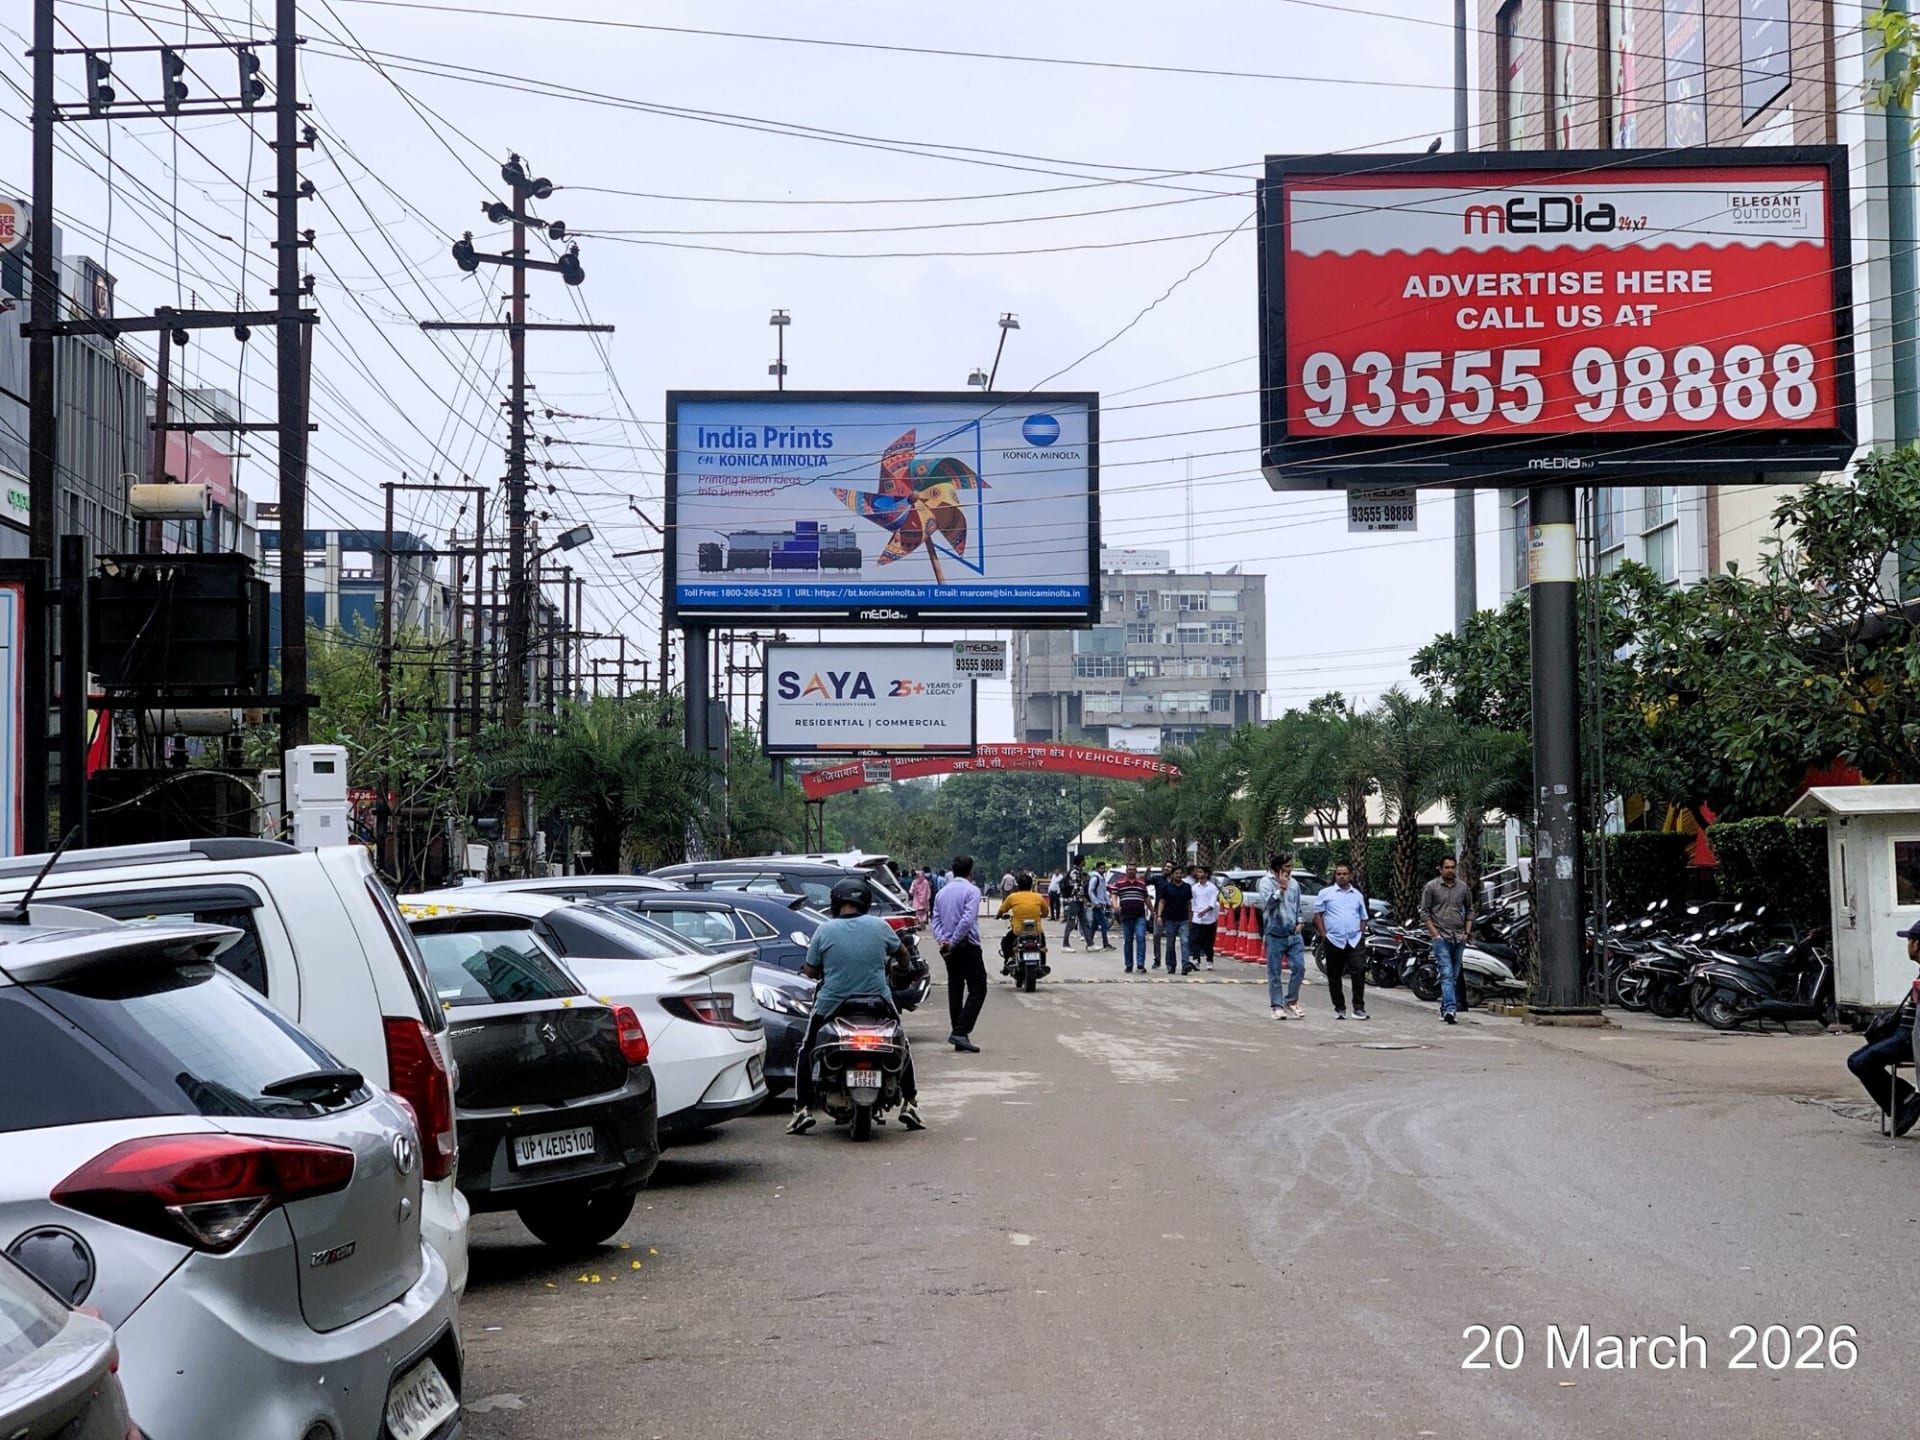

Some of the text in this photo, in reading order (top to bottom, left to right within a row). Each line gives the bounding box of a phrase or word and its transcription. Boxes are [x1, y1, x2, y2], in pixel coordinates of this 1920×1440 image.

[1732, 195, 1801, 207] ELEGANT
[1732, 207, 1801, 220] OUTDOOR
[1618, 215, 1648, 233] 24x7
[1402, 269, 1712, 299] ADVERTISE HERE
[1456, 303, 1658, 330] CALL US AT
[1302, 343, 1817, 428] 93555 98888
[698, 425, 833, 449] India Prints
[697, 454, 828, 467] on KONICA MINOLTA
[1002, 451, 1081, 460] KONICA MINOLTA
[698, 474, 801, 486] Printing billion ideas
[720, 486, 776, 497] businesses
[1352, 505, 1414, 522] 93555 98888
[683, 588, 1081, 599] Toll Free: 1800-266-2525 URL: https://bt.konicaminolta.in Email: marcom@bin.konicaminolta.in
[955, 658, 1004, 671] 93555 98888
[777, 670, 925, 700] SAYA 25+
[795, 719, 947, 727] RESIDENTIAL COMMERCIAL
[1050, 745, 1065, 758] क्षेत्र
[450, 1025, 486, 1039] SWIFT
[521, 1131, 594, 1161] UP14ED5100
